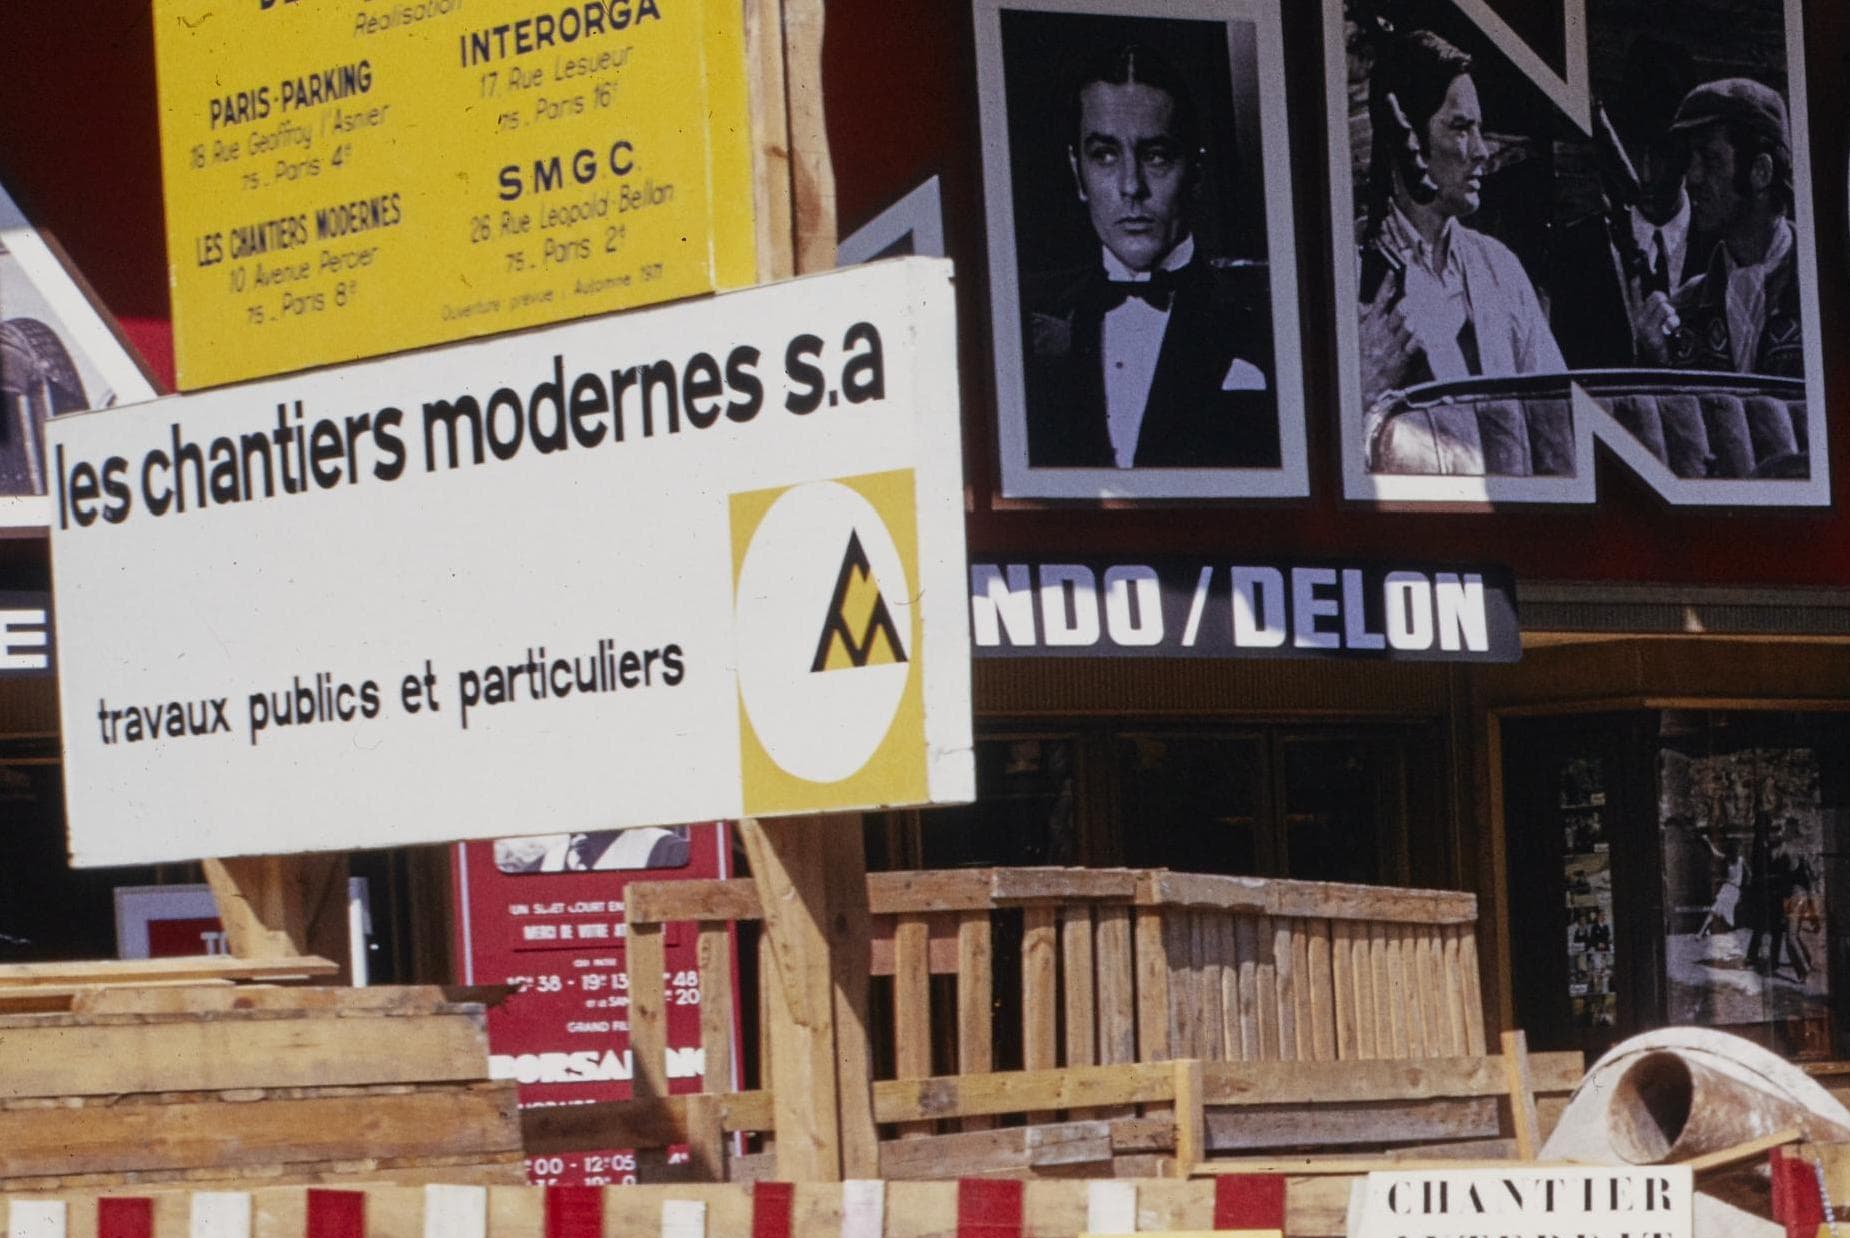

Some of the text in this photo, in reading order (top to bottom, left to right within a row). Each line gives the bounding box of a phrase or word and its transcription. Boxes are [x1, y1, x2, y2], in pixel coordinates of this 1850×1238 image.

[460, 0, 661, 68] INTERORGA
[508, 65, 543, 93] Rue
[553, 46, 634, 82] Lesueur
[535, 95, 584, 122] Paris
[274, 157, 322, 183] Paris
[196, 192, 402, 267] LES CHANTIERS MODERNES
[543, 236, 591, 265] Paris
[255, 262, 311, 290] Avenue
[282, 291, 326, 316] Paris
[56, 443, 130, 530] les
[141, 399, 406, 517] chantiers
[424, 345, 764, 473] modernes
[1231, 566, 1489, 652] DELON
[98, 639, 686, 744] travaux publics et particuliers
[1386, 1177, 1673, 1215] CHANTIER
